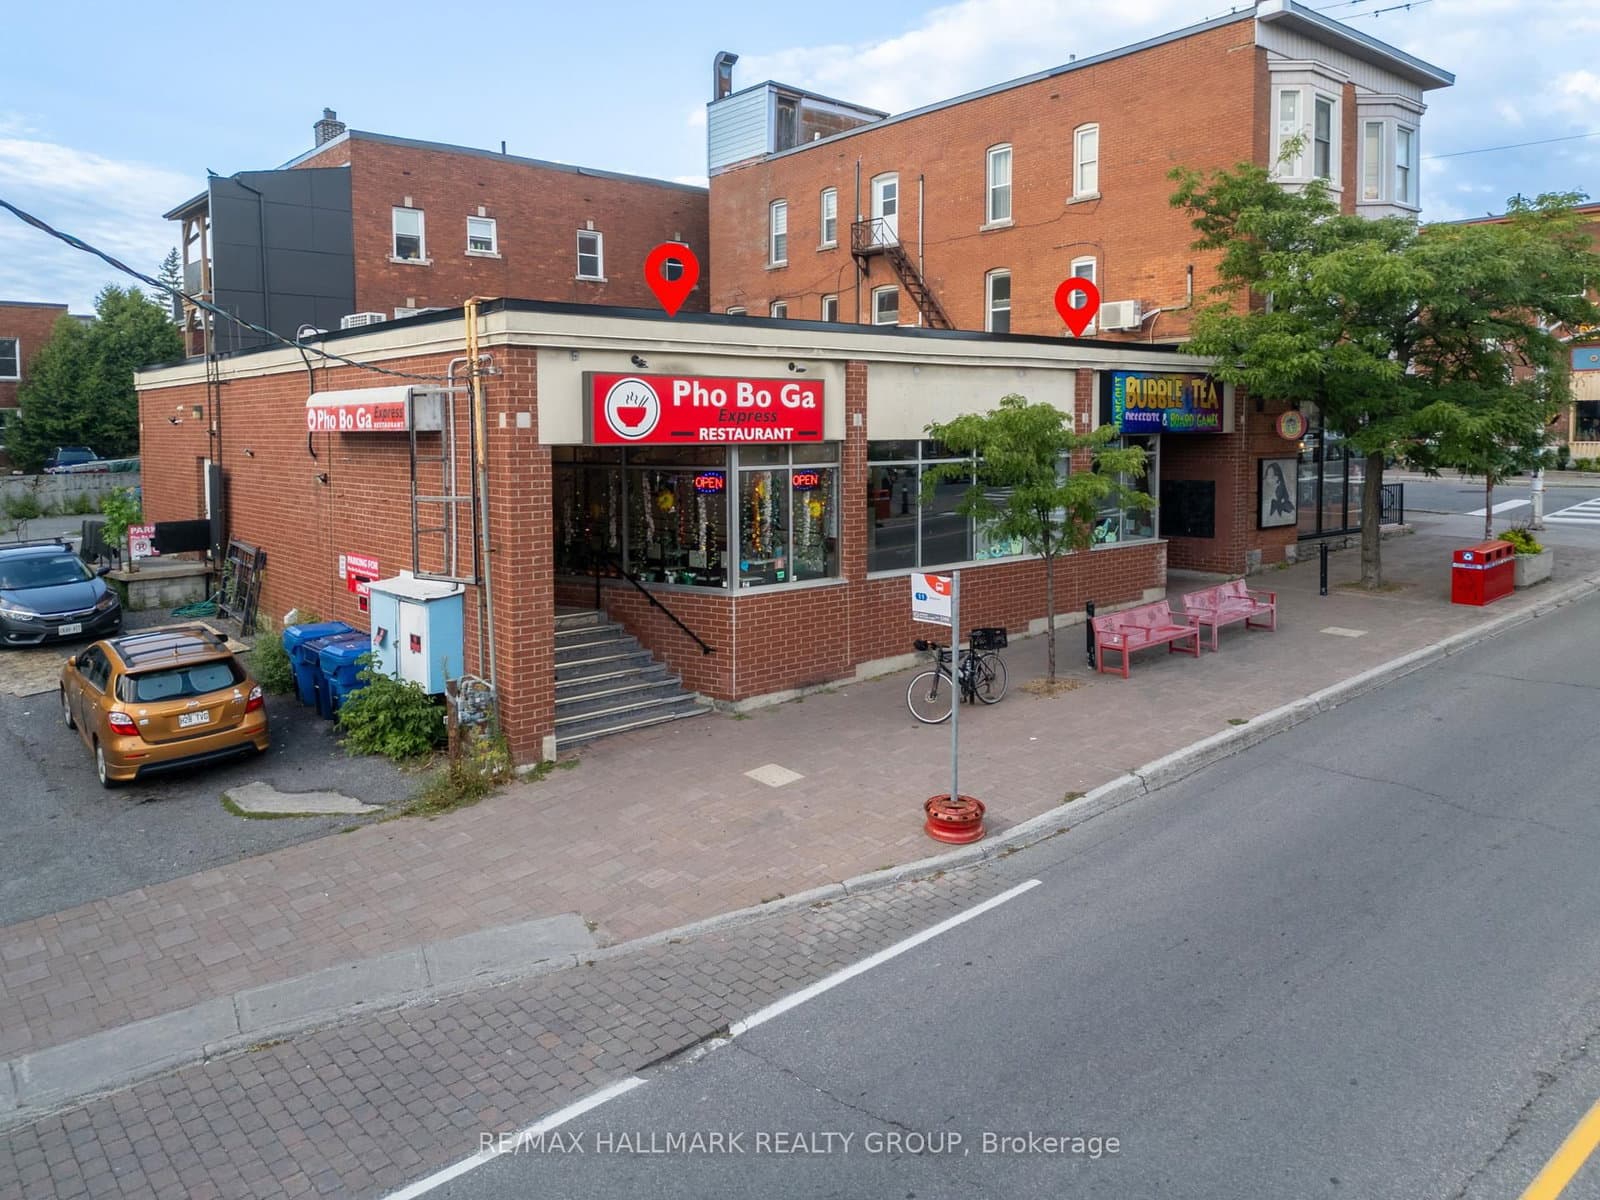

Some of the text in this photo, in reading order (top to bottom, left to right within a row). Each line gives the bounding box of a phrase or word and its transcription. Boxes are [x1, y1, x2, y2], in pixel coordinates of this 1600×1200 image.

[672, 380, 816, 409] Pho Bo Ga
[1125, 376, 1219, 409] BUBBLE TEA
[317, 407, 372, 429] Pho Bo Ga
[374, 405, 403, 421] Express
[718, 409, 778, 425] Express
[1162, 413, 1168, 426] &
[699, 427, 794, 441] RESTAURANT
[695, 476, 723, 489] OPEN
[792, 474, 818, 486] OPEN
